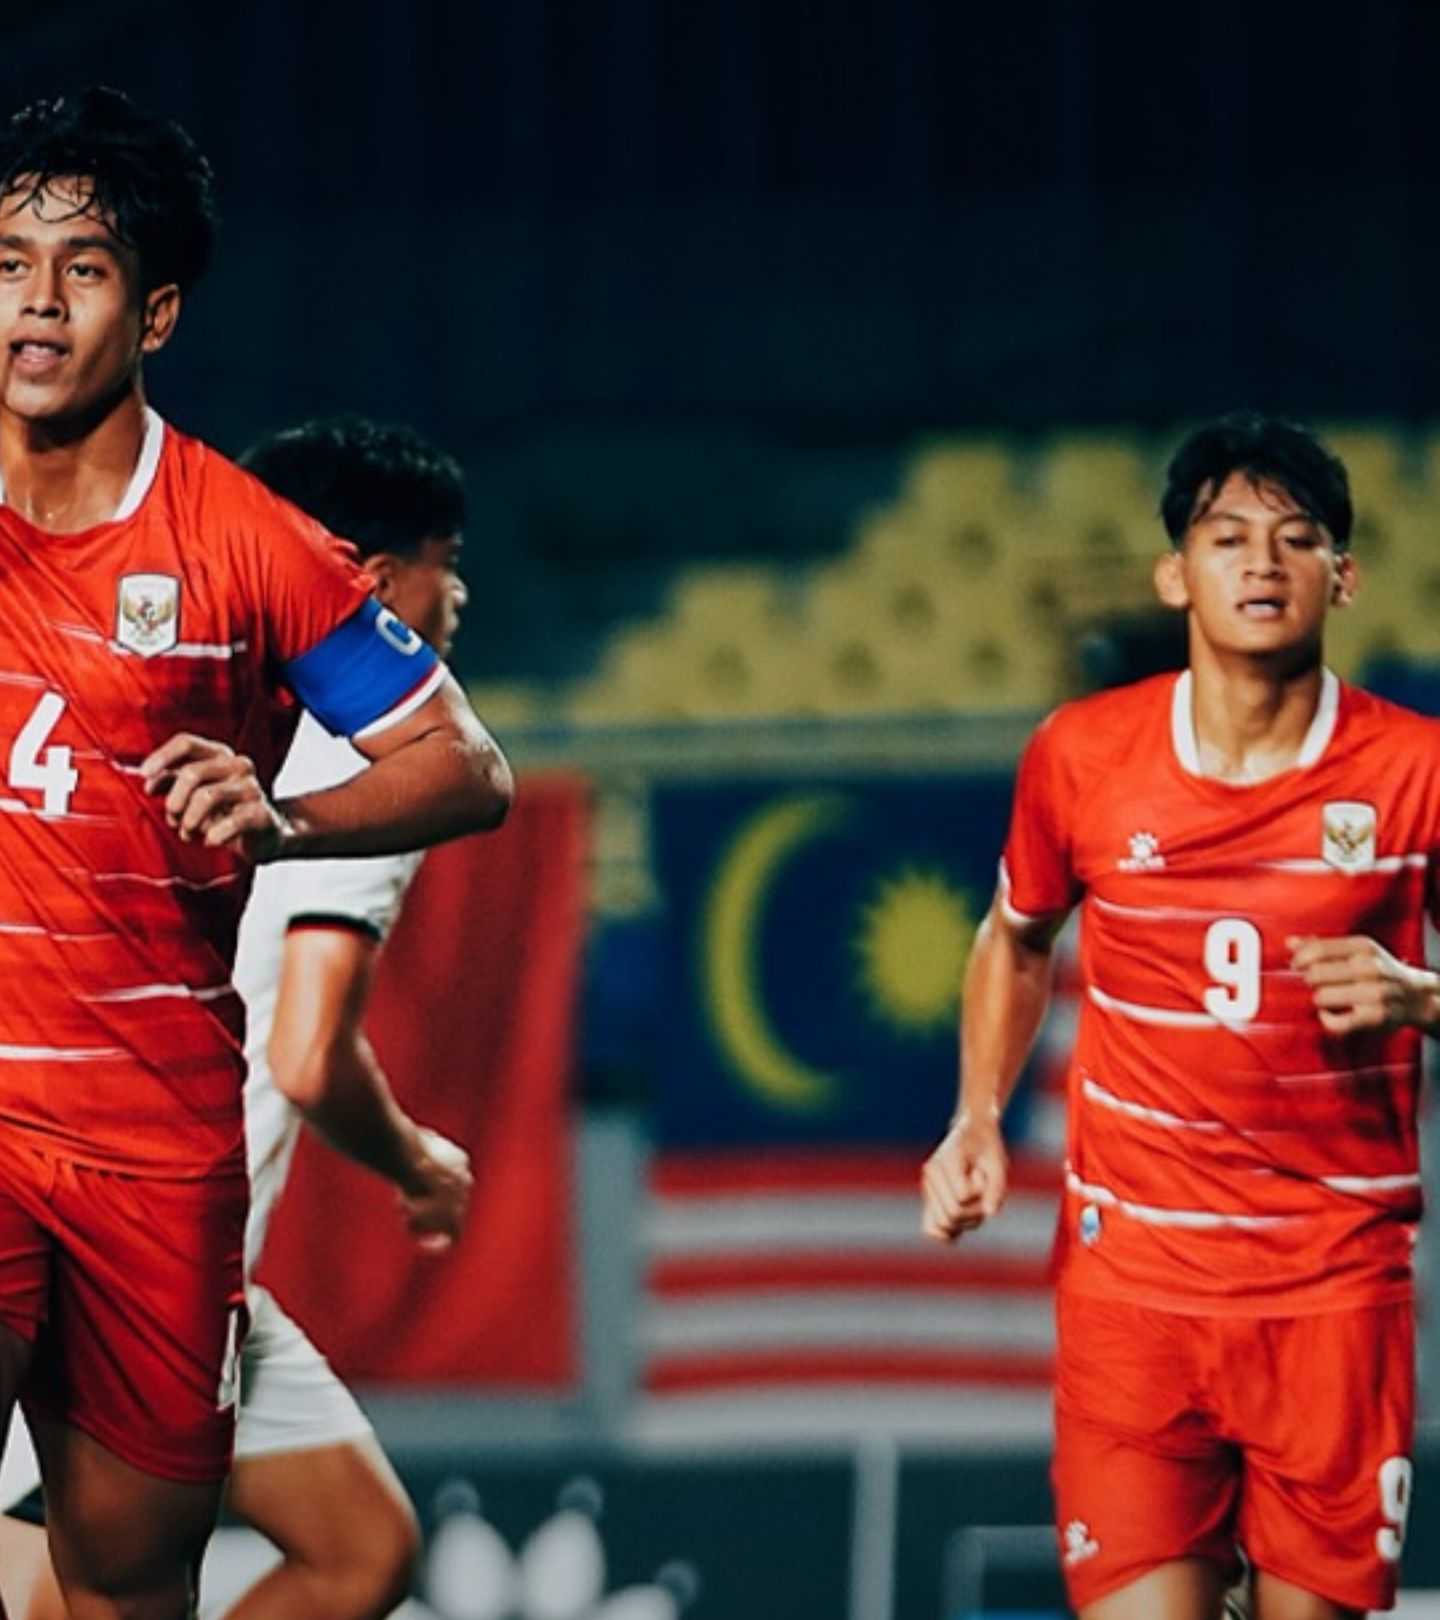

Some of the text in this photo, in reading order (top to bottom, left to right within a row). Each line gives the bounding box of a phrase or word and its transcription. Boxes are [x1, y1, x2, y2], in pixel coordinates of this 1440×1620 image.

[375, 607, 422, 656] C
[8, 690, 78, 815] 4
[1204, 918, 1261, 1024] 9
[1376, 1456, 1411, 1561] 9
